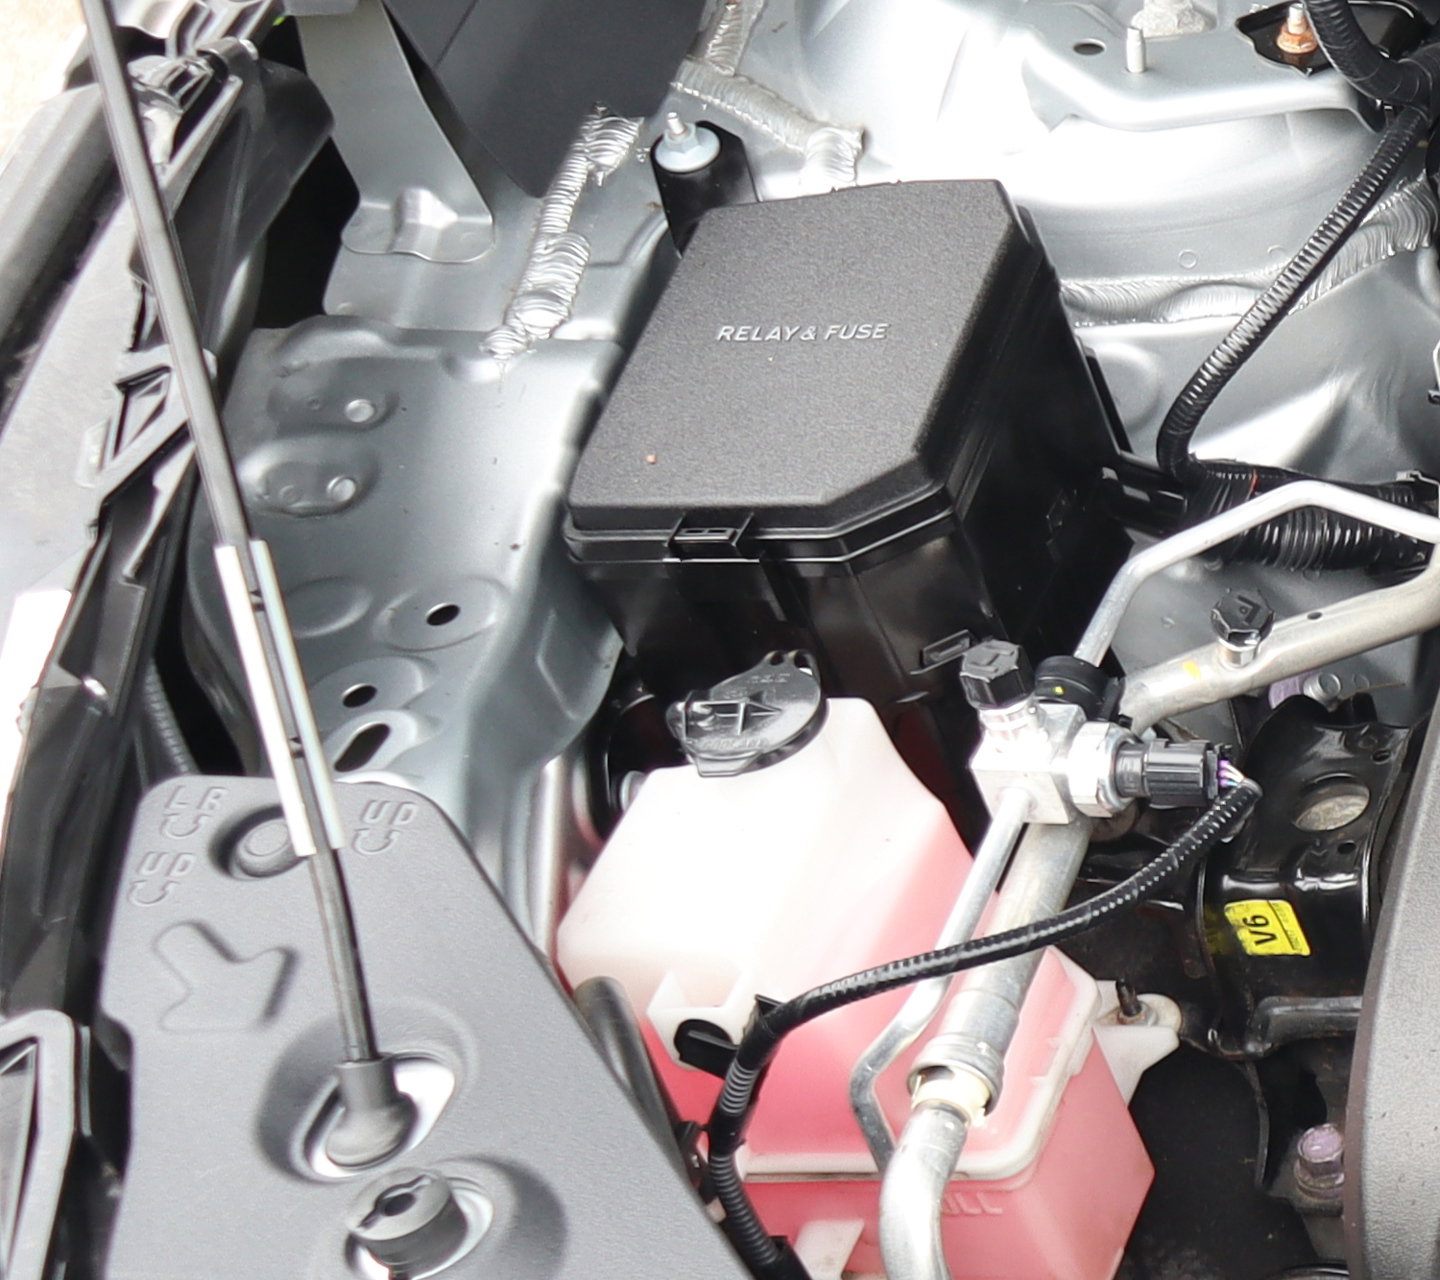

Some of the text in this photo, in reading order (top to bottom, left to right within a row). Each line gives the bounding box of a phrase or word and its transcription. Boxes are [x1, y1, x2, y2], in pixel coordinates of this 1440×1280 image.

[717, 325, 800, 341] RELAY
[824, 323, 891, 341] FUSE
[1242, 914, 1278, 946] V6
